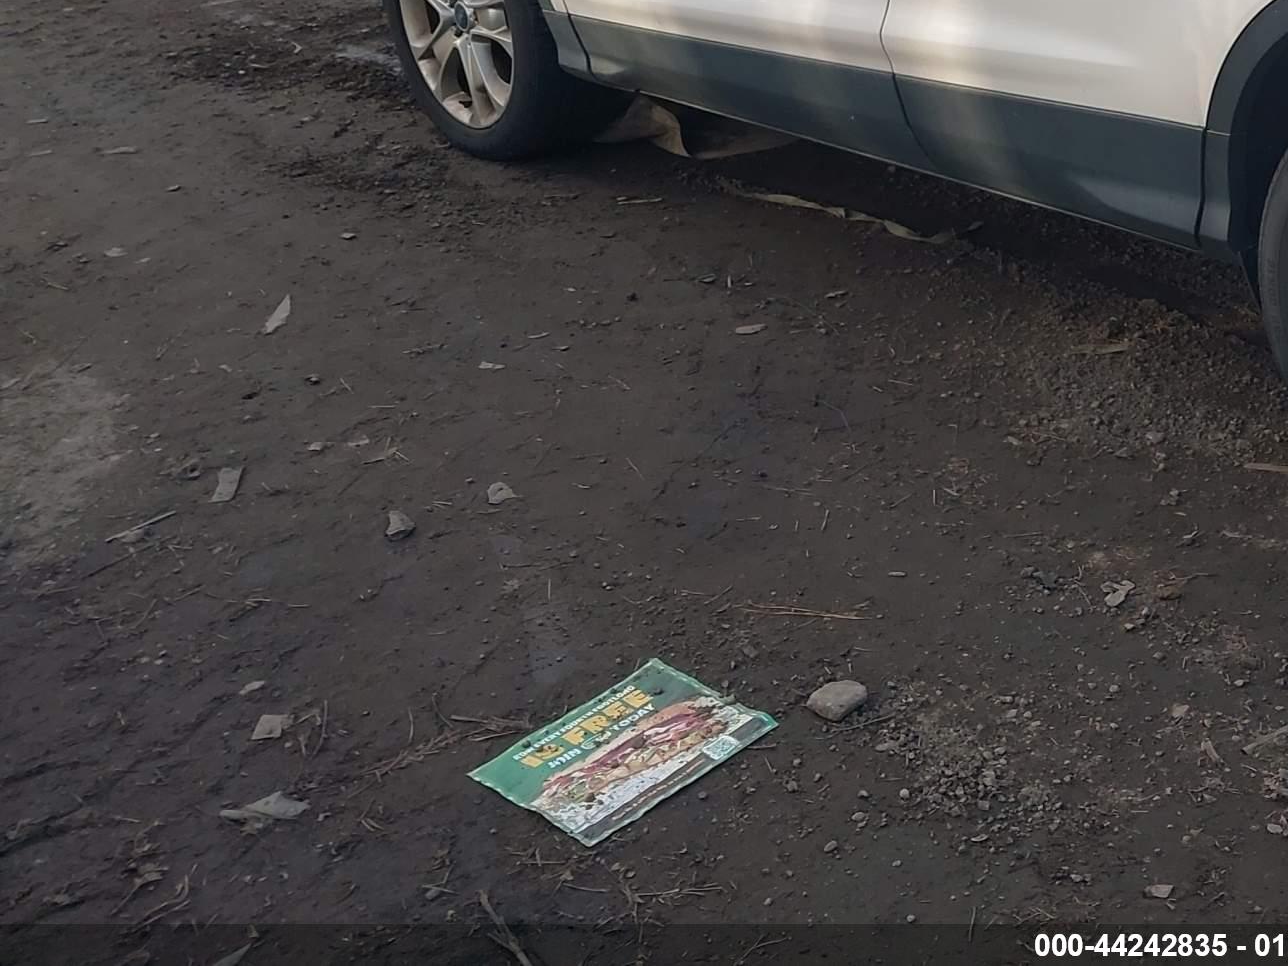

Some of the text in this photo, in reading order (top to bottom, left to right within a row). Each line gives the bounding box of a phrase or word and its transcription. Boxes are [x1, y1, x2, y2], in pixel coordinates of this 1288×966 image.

[560, 711, 594, 734] FOURTH
[561, 689, 654, 746] FREE
[610, 703, 656, 731] TODAY
